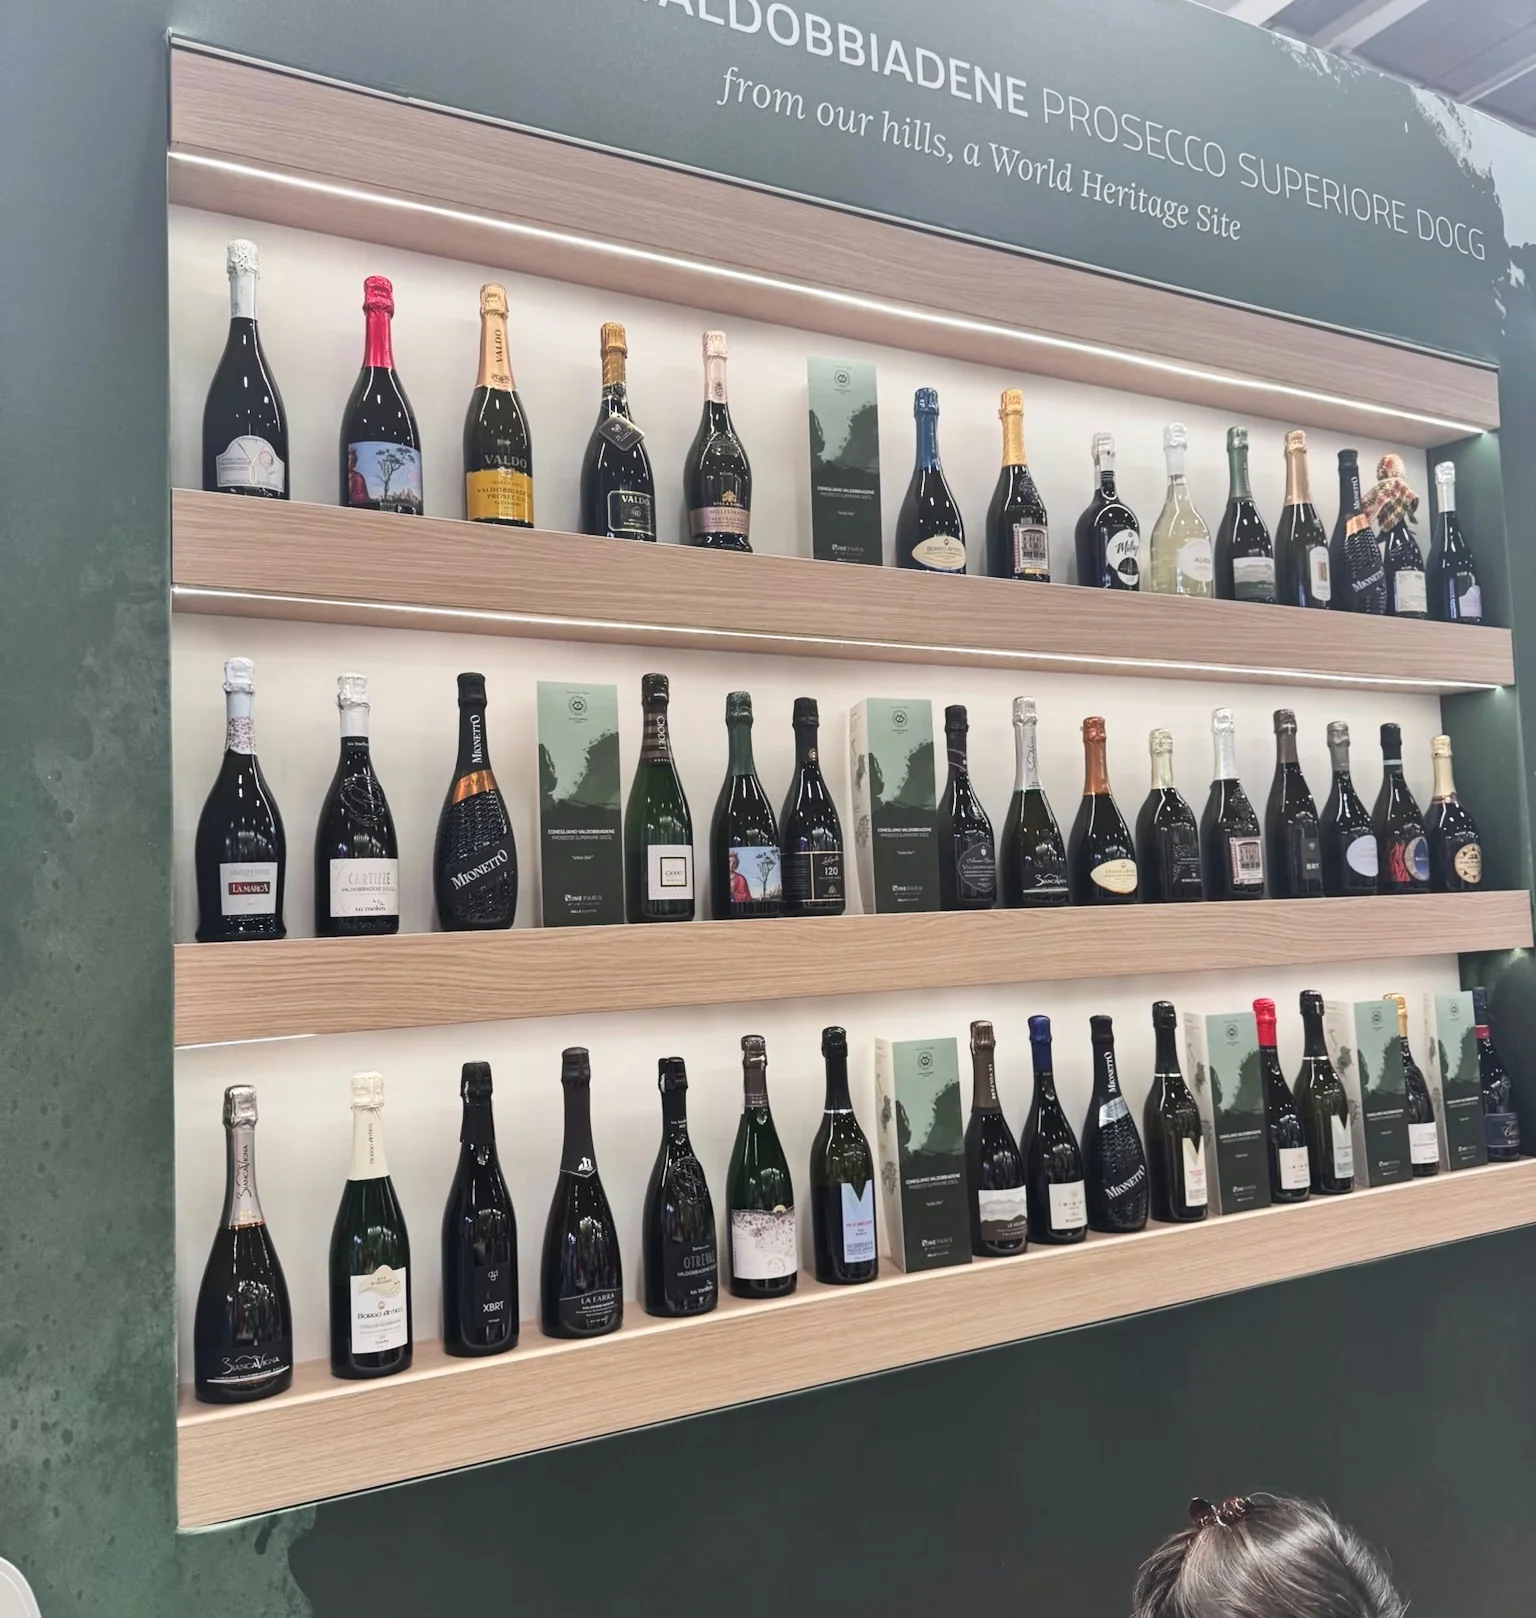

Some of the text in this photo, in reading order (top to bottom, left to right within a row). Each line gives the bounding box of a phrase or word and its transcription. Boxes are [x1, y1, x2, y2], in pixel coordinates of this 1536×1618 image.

[717, 66, 1242, 241] from our hills, a World Heritage Site
[1043, 87, 1226, 178] PROSECCO
[1238, 152, 1409, 234] SUPERIORE
[1416, 208, 1487, 261] DOCG
[495, 329, 503, 363] VALDO
[484, 454, 528, 469] VALDO
[621, 495, 650, 506] VALDO
[469, 714, 482, 764] MIONETTO
[657, 715, 667, 751] CIODET
[348, 872, 391, 885] CARTIZZE
[451, 848, 508, 891] MIONETTO
[824, 866, 839, 876] 120
[243, 883, 269, 893] MARCA
[1104, 1051, 1118, 1093] MIONETTO
[1105, 1164, 1145, 1200] MIONETTO
[482, 1300, 505, 1313] XBRT
[580, 1296, 595, 1305] LA
